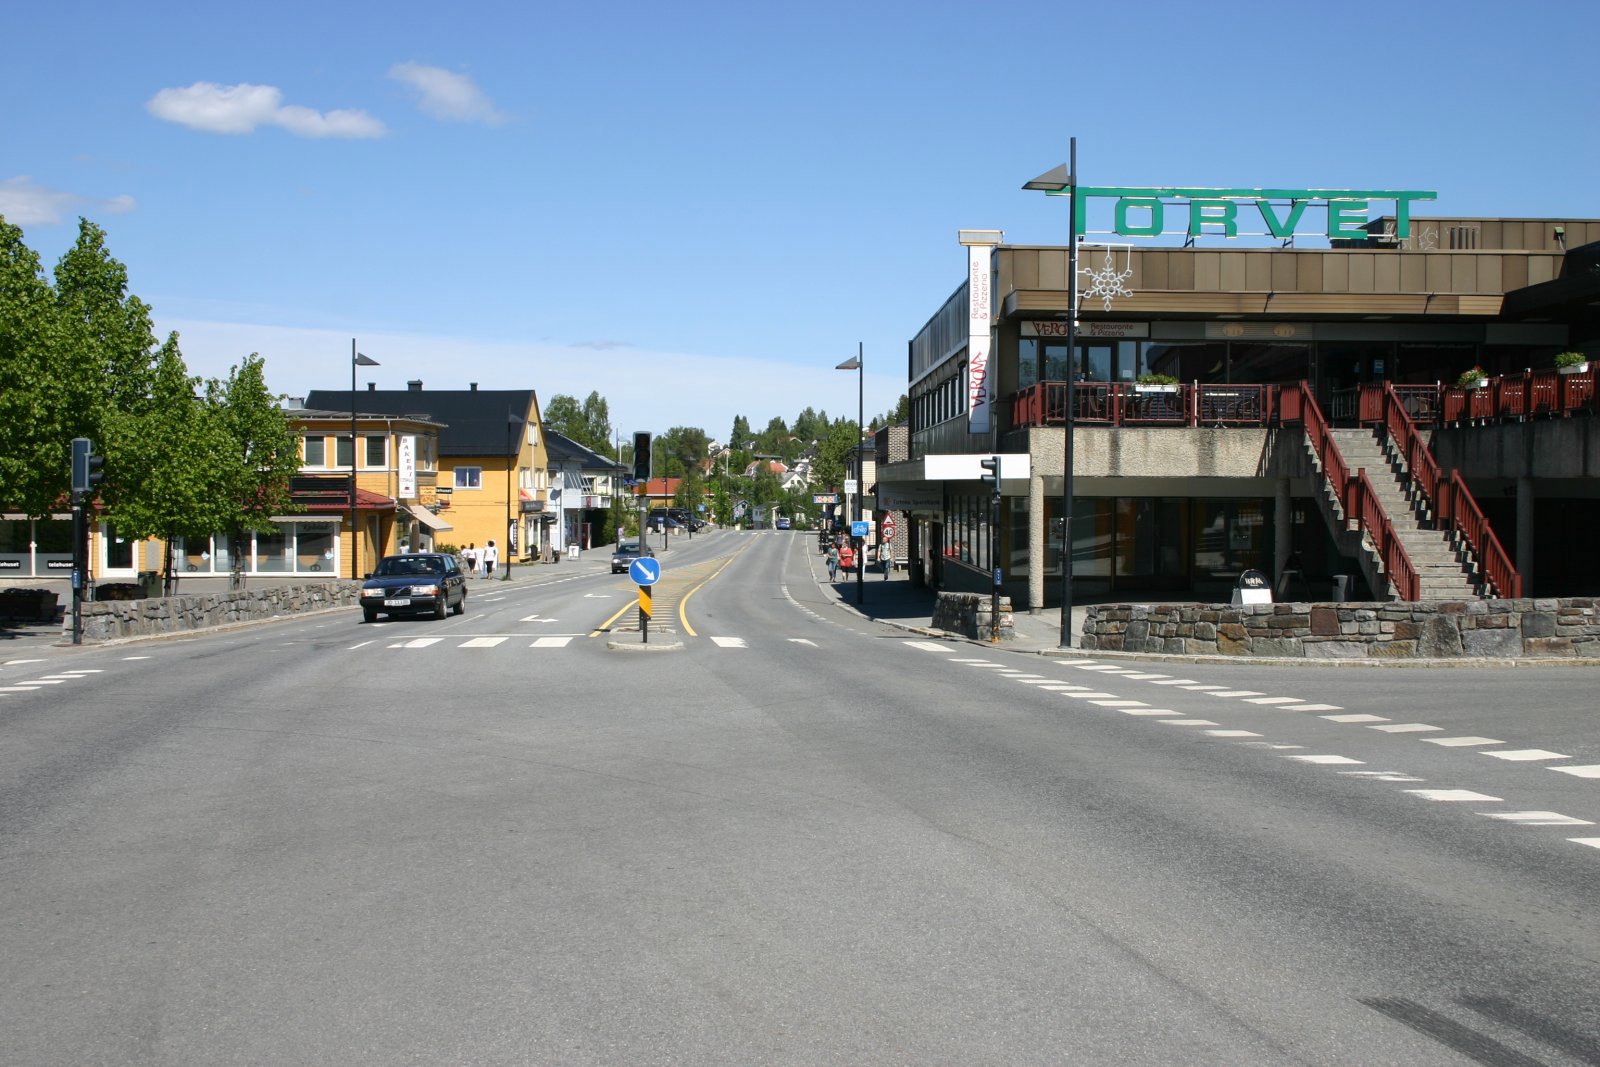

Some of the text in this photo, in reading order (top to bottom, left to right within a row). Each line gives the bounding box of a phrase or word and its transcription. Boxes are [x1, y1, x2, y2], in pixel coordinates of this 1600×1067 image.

[1046, 186, 1437, 239] TORVET
[971, 261, 979, 319] Restaurante
[980, 273, 988, 309] Pizzeria
[1034, 321, 1080, 336] VERO
[1090, 322, 1134, 330] Restaurante
